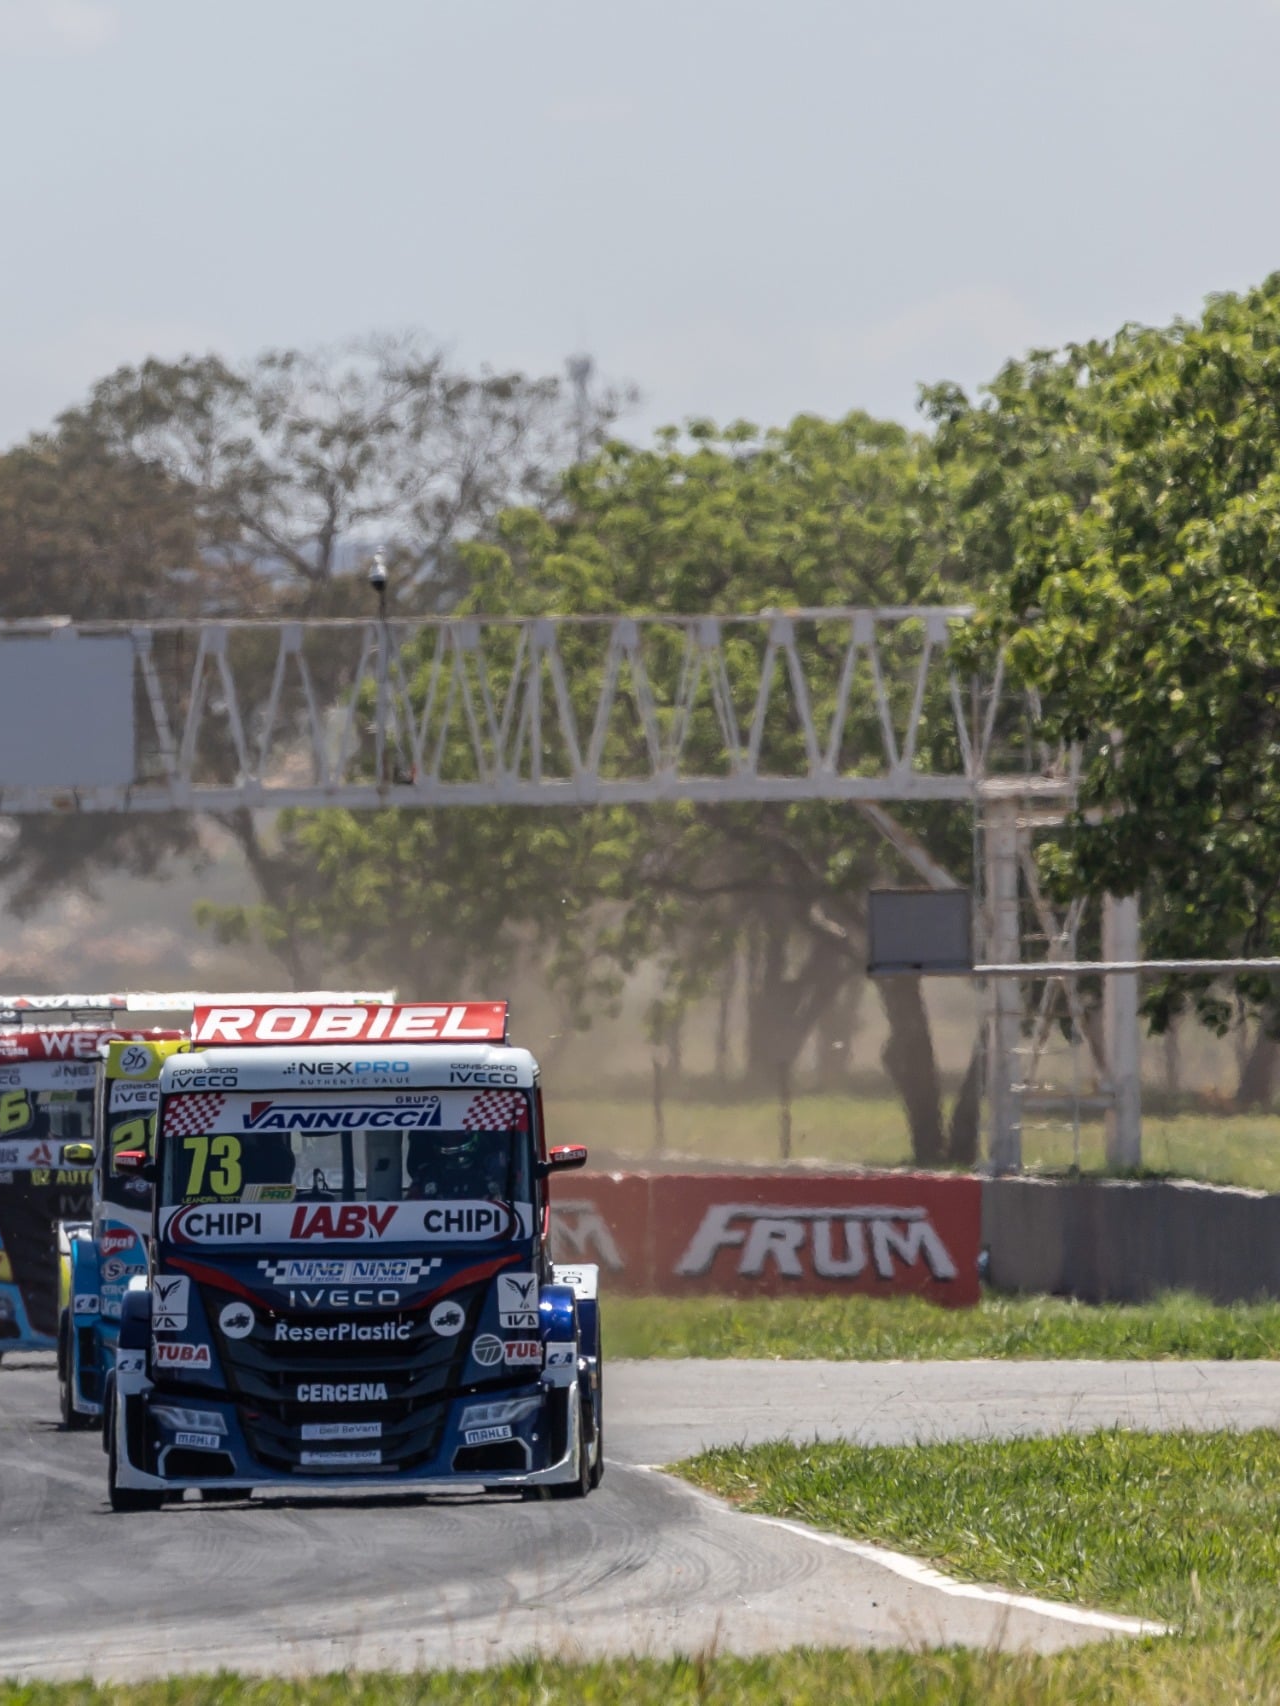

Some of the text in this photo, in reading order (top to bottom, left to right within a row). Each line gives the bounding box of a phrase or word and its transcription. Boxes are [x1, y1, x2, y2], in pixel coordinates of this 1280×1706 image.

[197, 1007, 490, 1041] ROBIEL
[298, 1061, 410, 1076] NEXPRO
[171, 1076, 238, 1089] IVECO
[374, 1077, 410, 1085] VALUE
[450, 1072, 518, 1085] IVECO
[395, 1095, 440, 1104] GRUPO
[183, 1135, 242, 1196] 73
[184, 1212, 262, 1237] CHIPI
[423, 1209, 501, 1233] CHIPI
[675, 1202, 957, 1280] FRUM
[290, 1261, 407, 1277] NINO NINO
[288, 1288, 400, 1308] IVECO
[274, 1320, 411, 1342] ReserPlastic
[157, 1344, 209, 1362] TUBA
[297, 1382, 389, 1402] CERCENA
[467, 1424, 511, 1442] MAHLE
